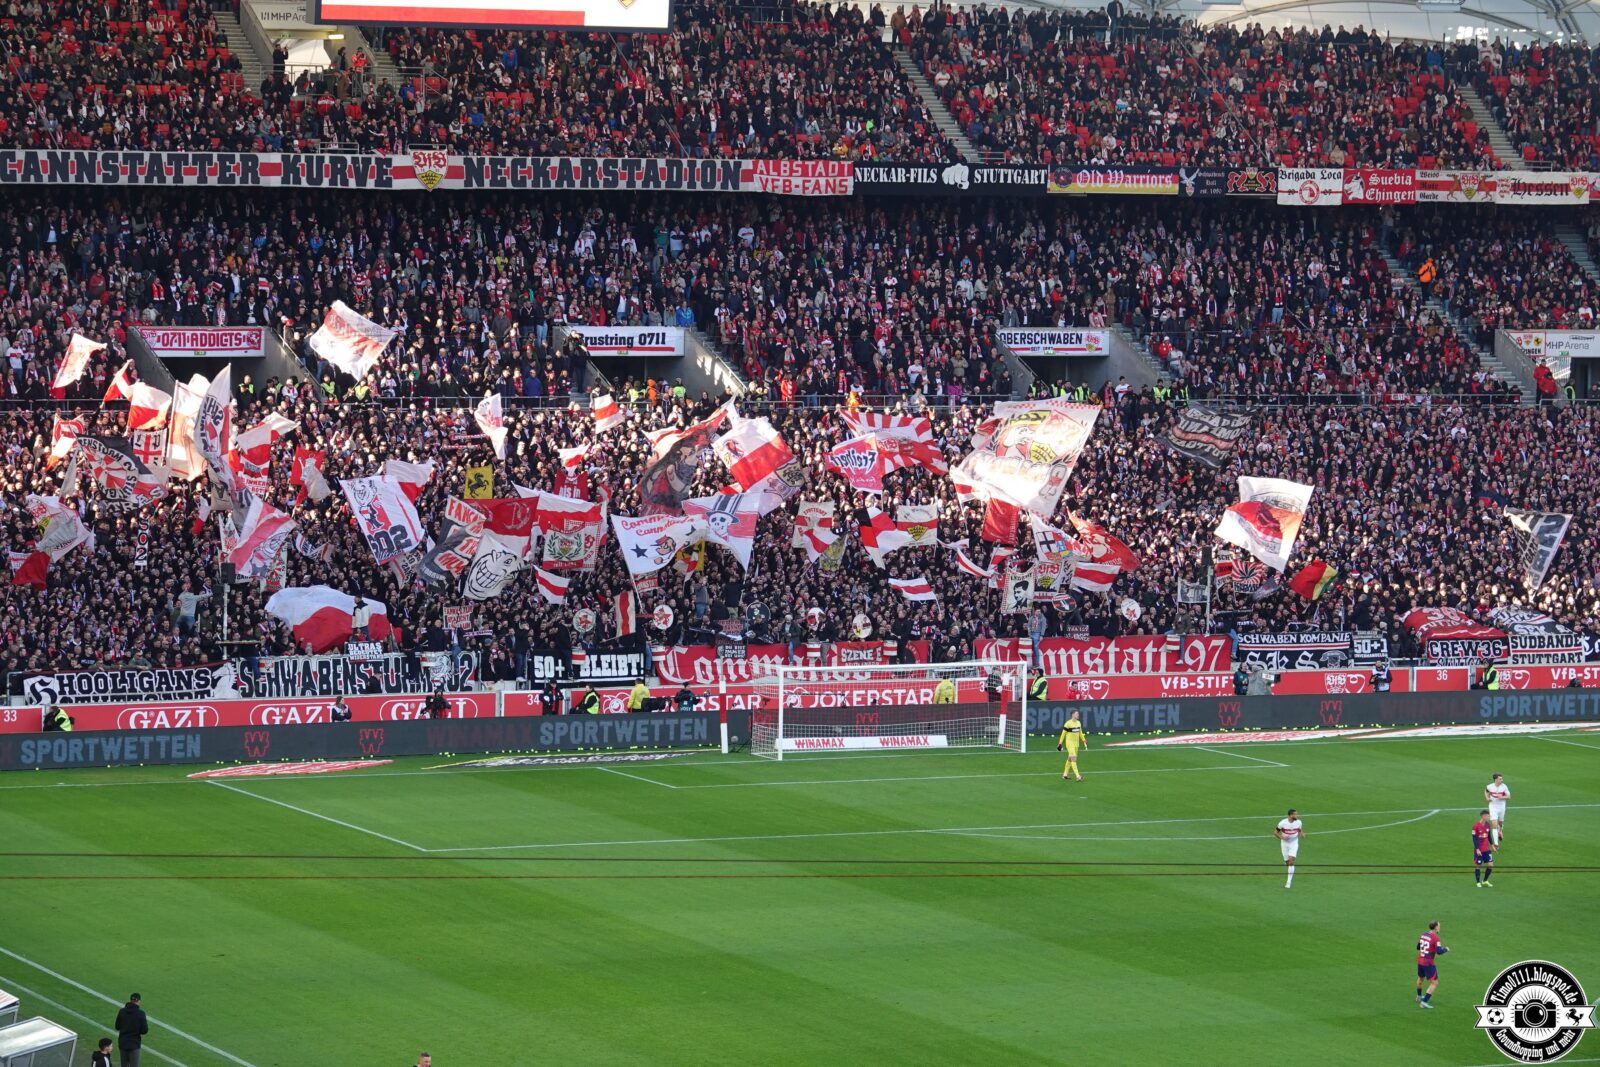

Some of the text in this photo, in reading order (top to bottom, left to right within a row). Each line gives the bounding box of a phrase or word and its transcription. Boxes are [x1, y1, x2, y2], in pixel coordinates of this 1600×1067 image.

[271, 12, 291, 21] MHP
[0, 150, 394, 188] CANNSTATTER KURVE
[463, 157, 742, 190] NECKARSTADION
[755, 160, 851, 177] ALBSTADT
[854, 167, 1048, 185] NECKAR-FILS STUTTGART
[1279, 169, 1342, 182] Brigada Loca
[759, 178, 849, 195] VFB-FANS
[1076, 170, 1173, 189] Old Warriors
[1369, 173, 1413, 186] Suebia
[1366, 188, 1416, 203] Ehingen
[1511, 178, 1569, 199] Hessen
[161, 332, 243, 347] 0711 ADDICTS
[638, 332, 666, 346] 0711
[1565, 341, 1590, 350] Arena
[1238, 632, 1297, 644] SCHWABEN
[1299, 632, 1351, 644] KOMPANIE
[347, 642, 382, 651] ULTRAS
[1353, 639, 1388, 653] 50+1
[841, 647, 872, 661] SZENE
[1184, 640, 1226, 673] 97
[1511, 652, 1583, 665] STUTTGART
[579, 652, 645, 678] BLEIBT!
[55, 668, 212, 696] HOOLIGANS
[1436, 670, 1448, 681] 36
[527, 694, 540, 706] 34
[810, 687, 935, 708] JOKERSTAR
[3, 710, 18, 722] 33
[129, 708, 208, 729] GAZI
[539, 718, 708, 746] SPORTWETTEN
[793, 738, 845, 749] WINAMAX
[879, 735, 930, 747] WINAMAX
[20, 733, 201, 765] SPORTWETTEN
